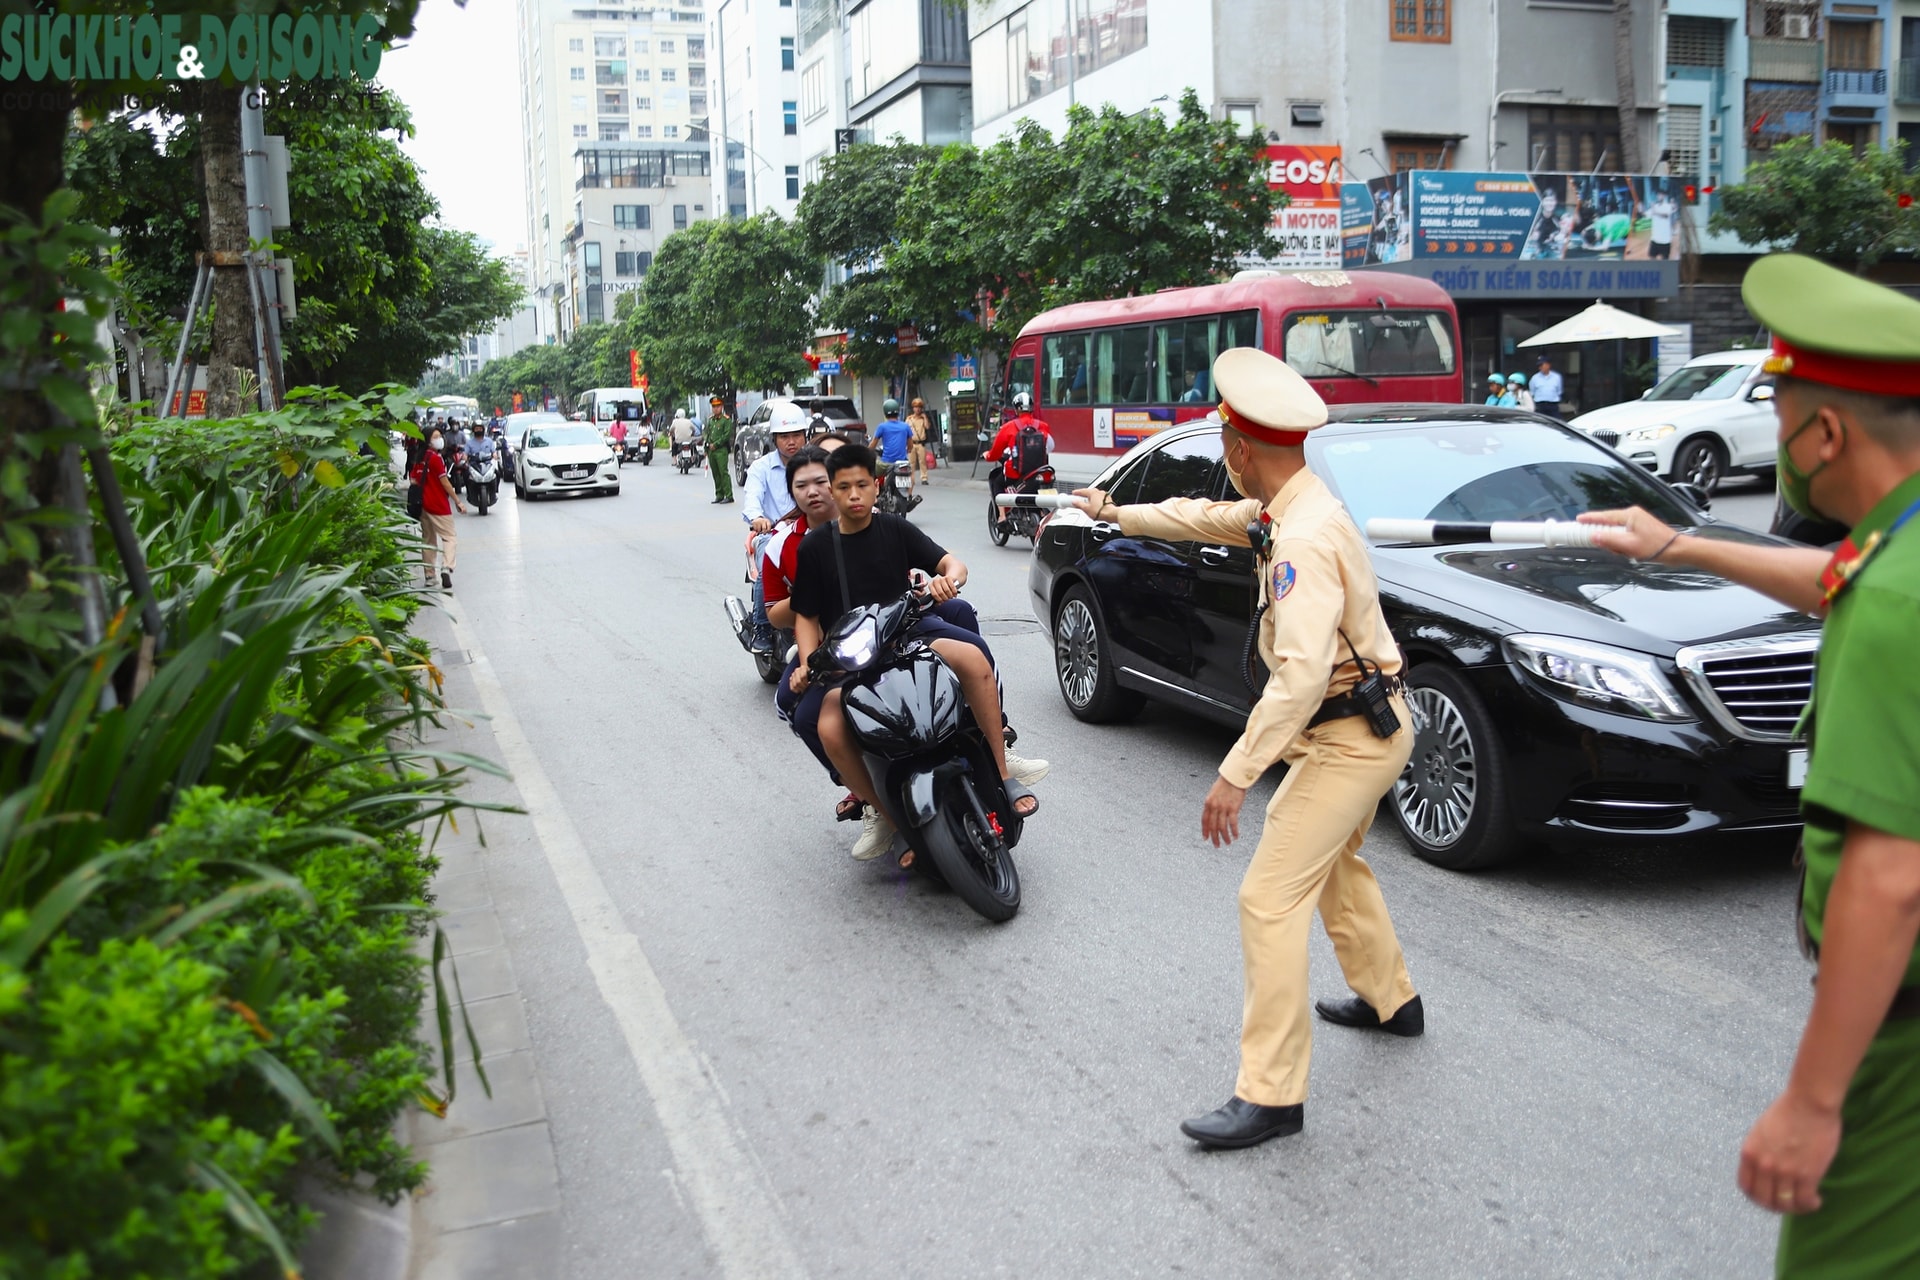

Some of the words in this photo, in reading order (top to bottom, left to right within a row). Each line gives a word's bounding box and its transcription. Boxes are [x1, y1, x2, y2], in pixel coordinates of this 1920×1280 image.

[1466, 195, 1485, 204] GYM
[1508, 208, 1531, 217] YOGA
[1287, 213, 1338, 229] MOTOR
[1420, 219, 1446, 227] ZUMBA
[1451, 219, 1479, 228] DANCE
[1311, 236, 1321, 250] XE
[1432, 265, 1479, 290] CHỐT
[1485, 264, 1531, 290] KIỂM
[1537, 268, 1582, 290] SOÁT
[1588, 270, 1612, 290] AN
[1618, 270, 1661, 290] NINH
